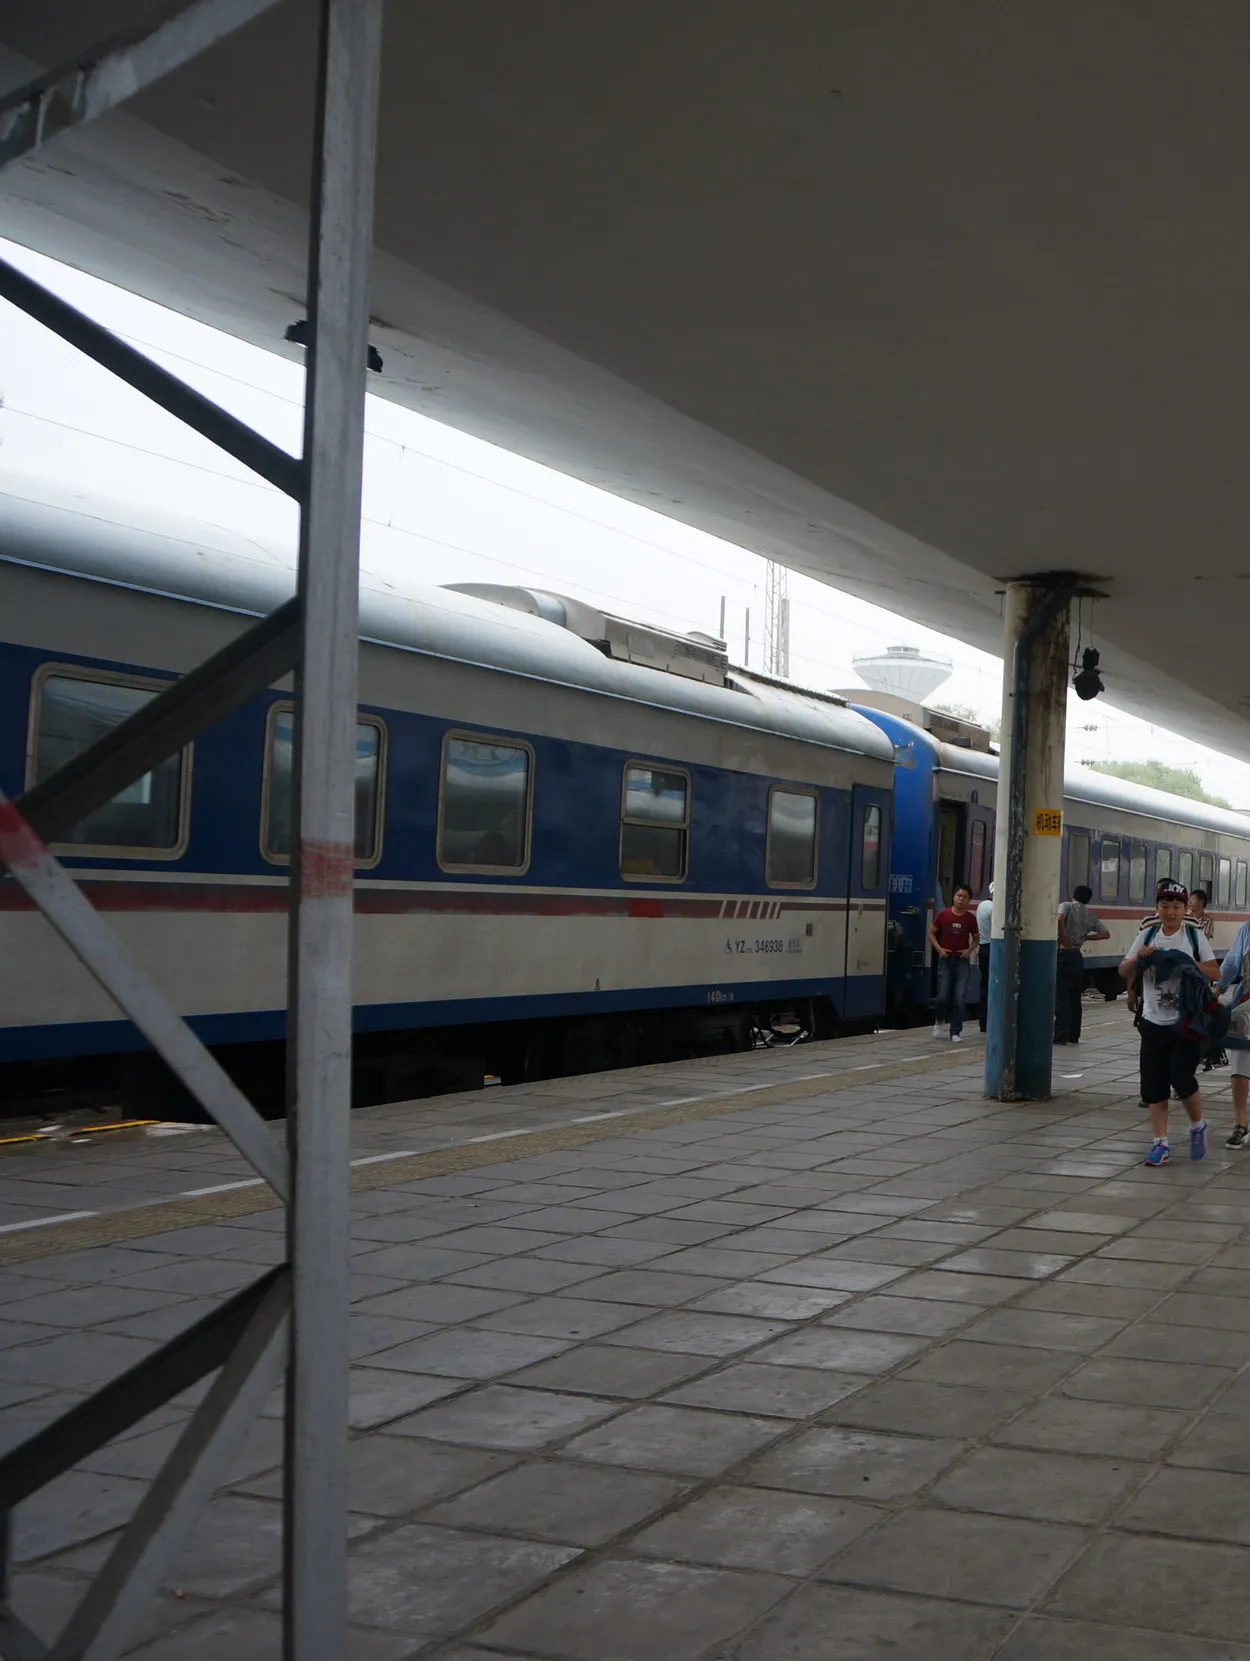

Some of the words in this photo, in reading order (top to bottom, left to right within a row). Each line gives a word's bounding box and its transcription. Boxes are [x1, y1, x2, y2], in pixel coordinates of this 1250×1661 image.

[1036, 812, 1061, 831] 机动车
[1163, 883, 1185, 894] JOY
[754, 939, 784, 953] 346938
